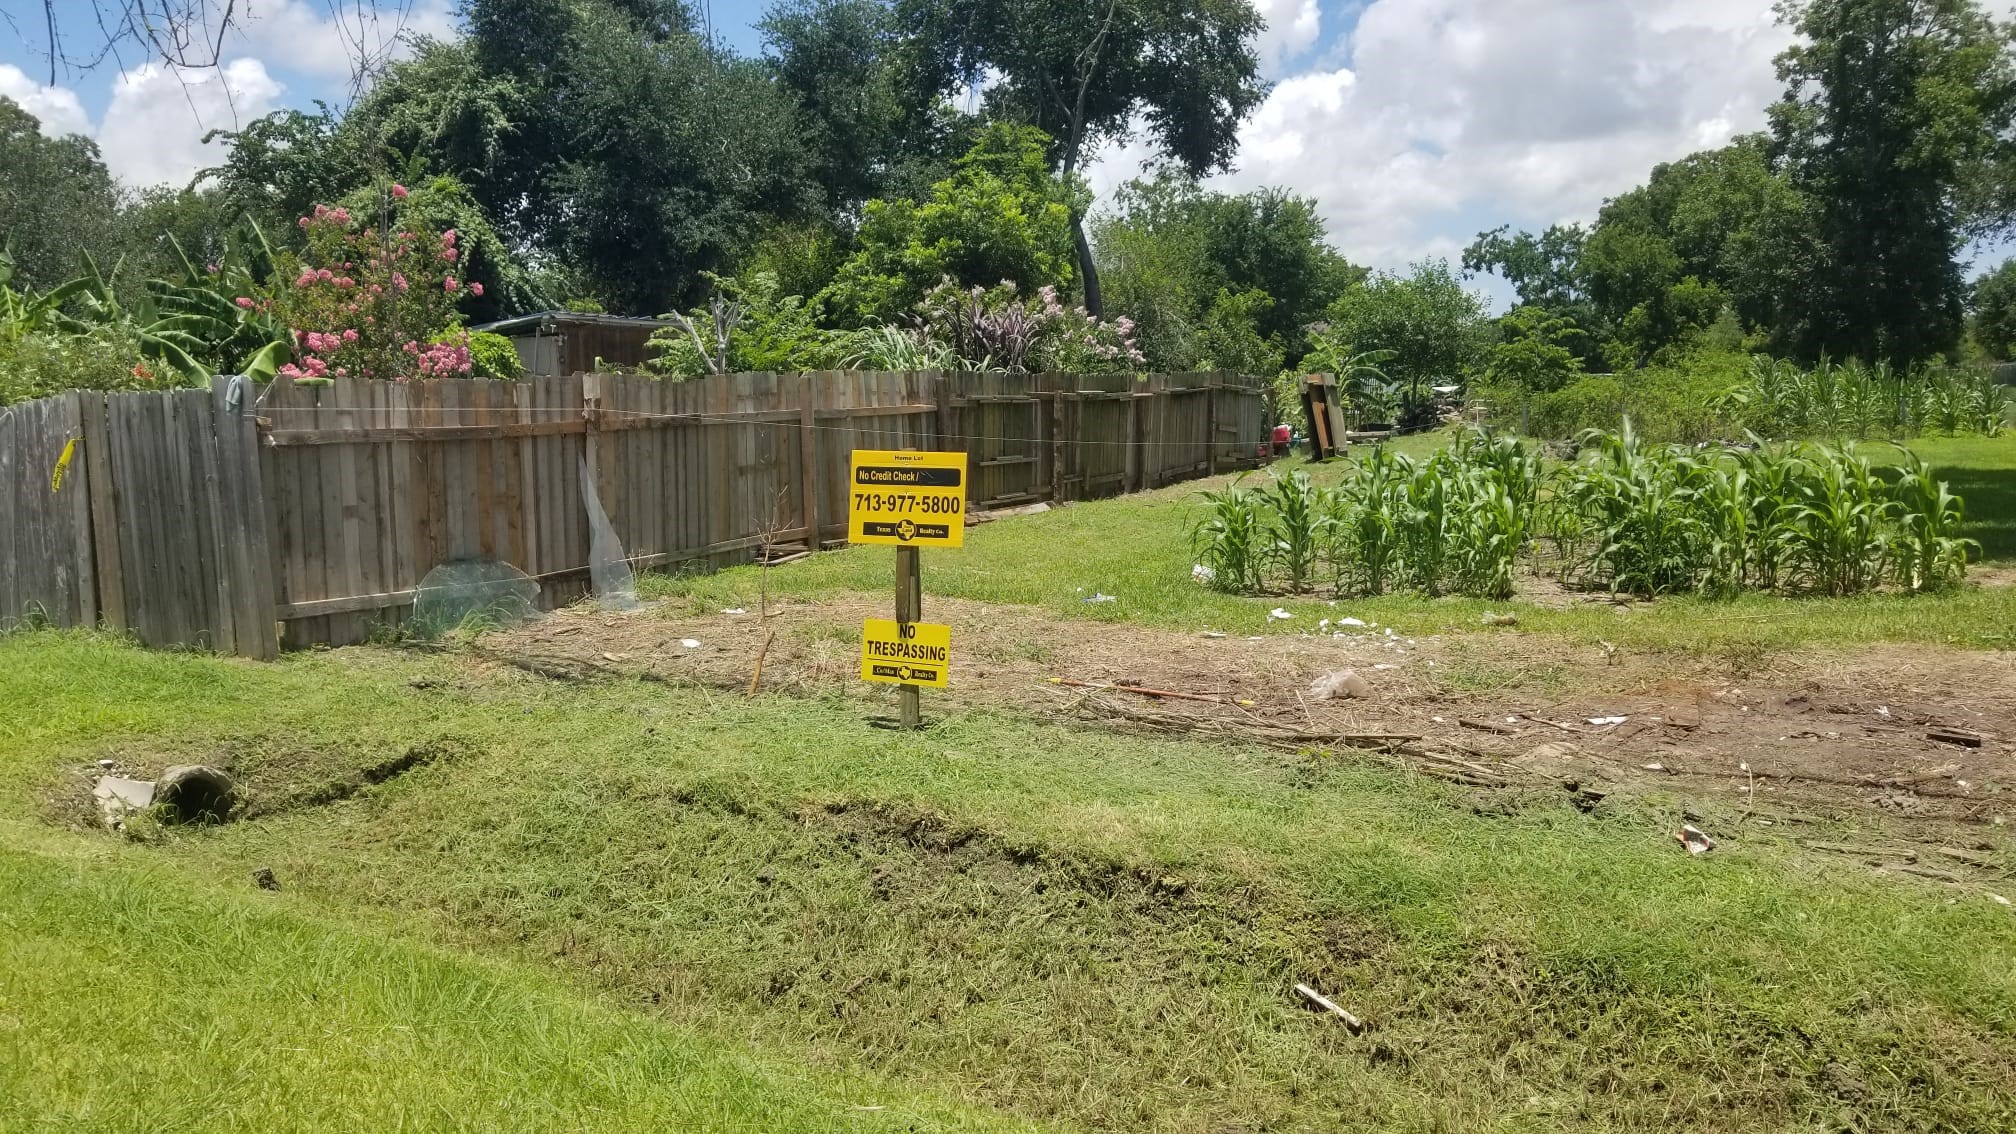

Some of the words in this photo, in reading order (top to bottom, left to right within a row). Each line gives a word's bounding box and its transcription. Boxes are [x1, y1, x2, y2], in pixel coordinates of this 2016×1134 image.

[859, 470, 869, 480] No
[871, 470, 892, 481] Credit
[893, 471, 915, 481] Check
[854, 493, 960, 514] 713-977-5800
[920, 527, 935, 535] Realty
[900, 624, 916, 639] NO
[867, 640, 946, 662] TRESPASSING
